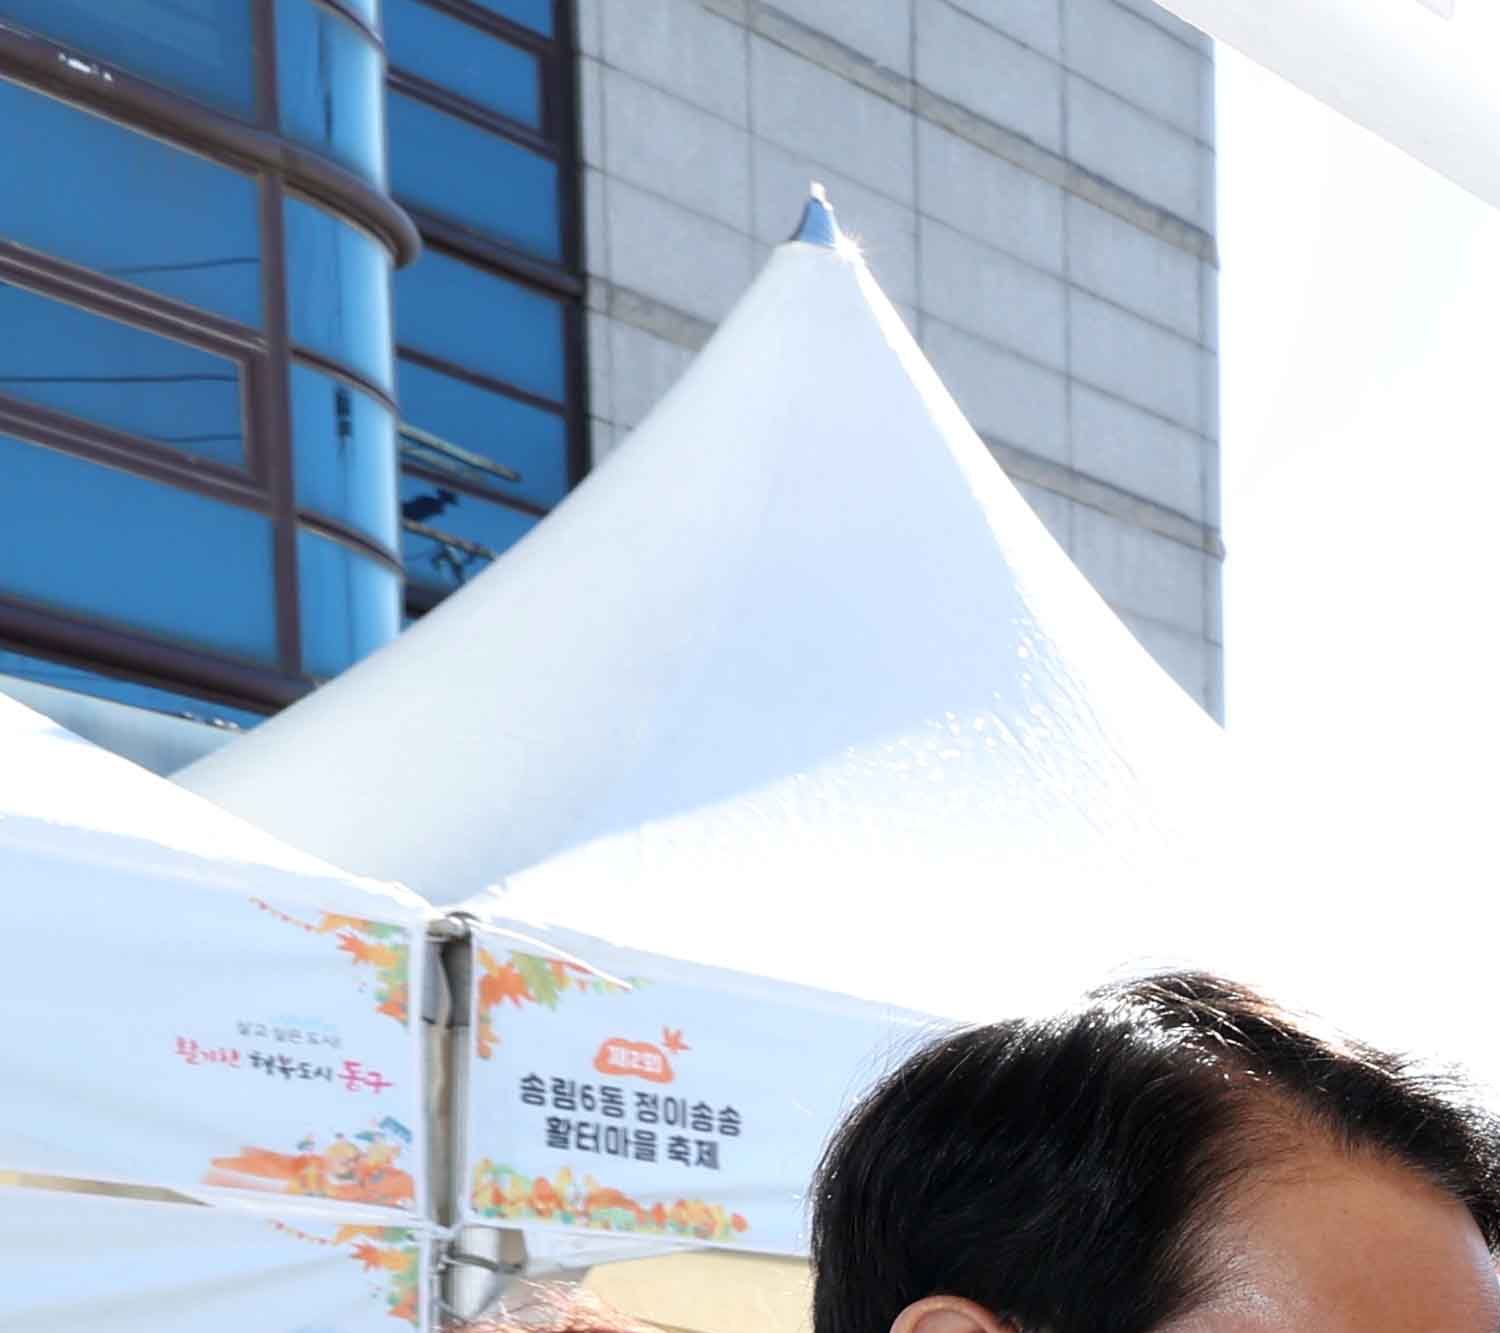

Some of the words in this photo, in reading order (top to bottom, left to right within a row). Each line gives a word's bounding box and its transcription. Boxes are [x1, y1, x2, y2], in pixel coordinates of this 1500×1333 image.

[248, 1051, 333, 1083] 행복도시
[336, 1060, 394, 1094] 동구
[519, 1072, 626, 1119] 송림6동
[634, 1089, 743, 1138] 정이송송
[545, 1116, 658, 1163] 활터마을
[668, 1134, 721, 1171] 축제
